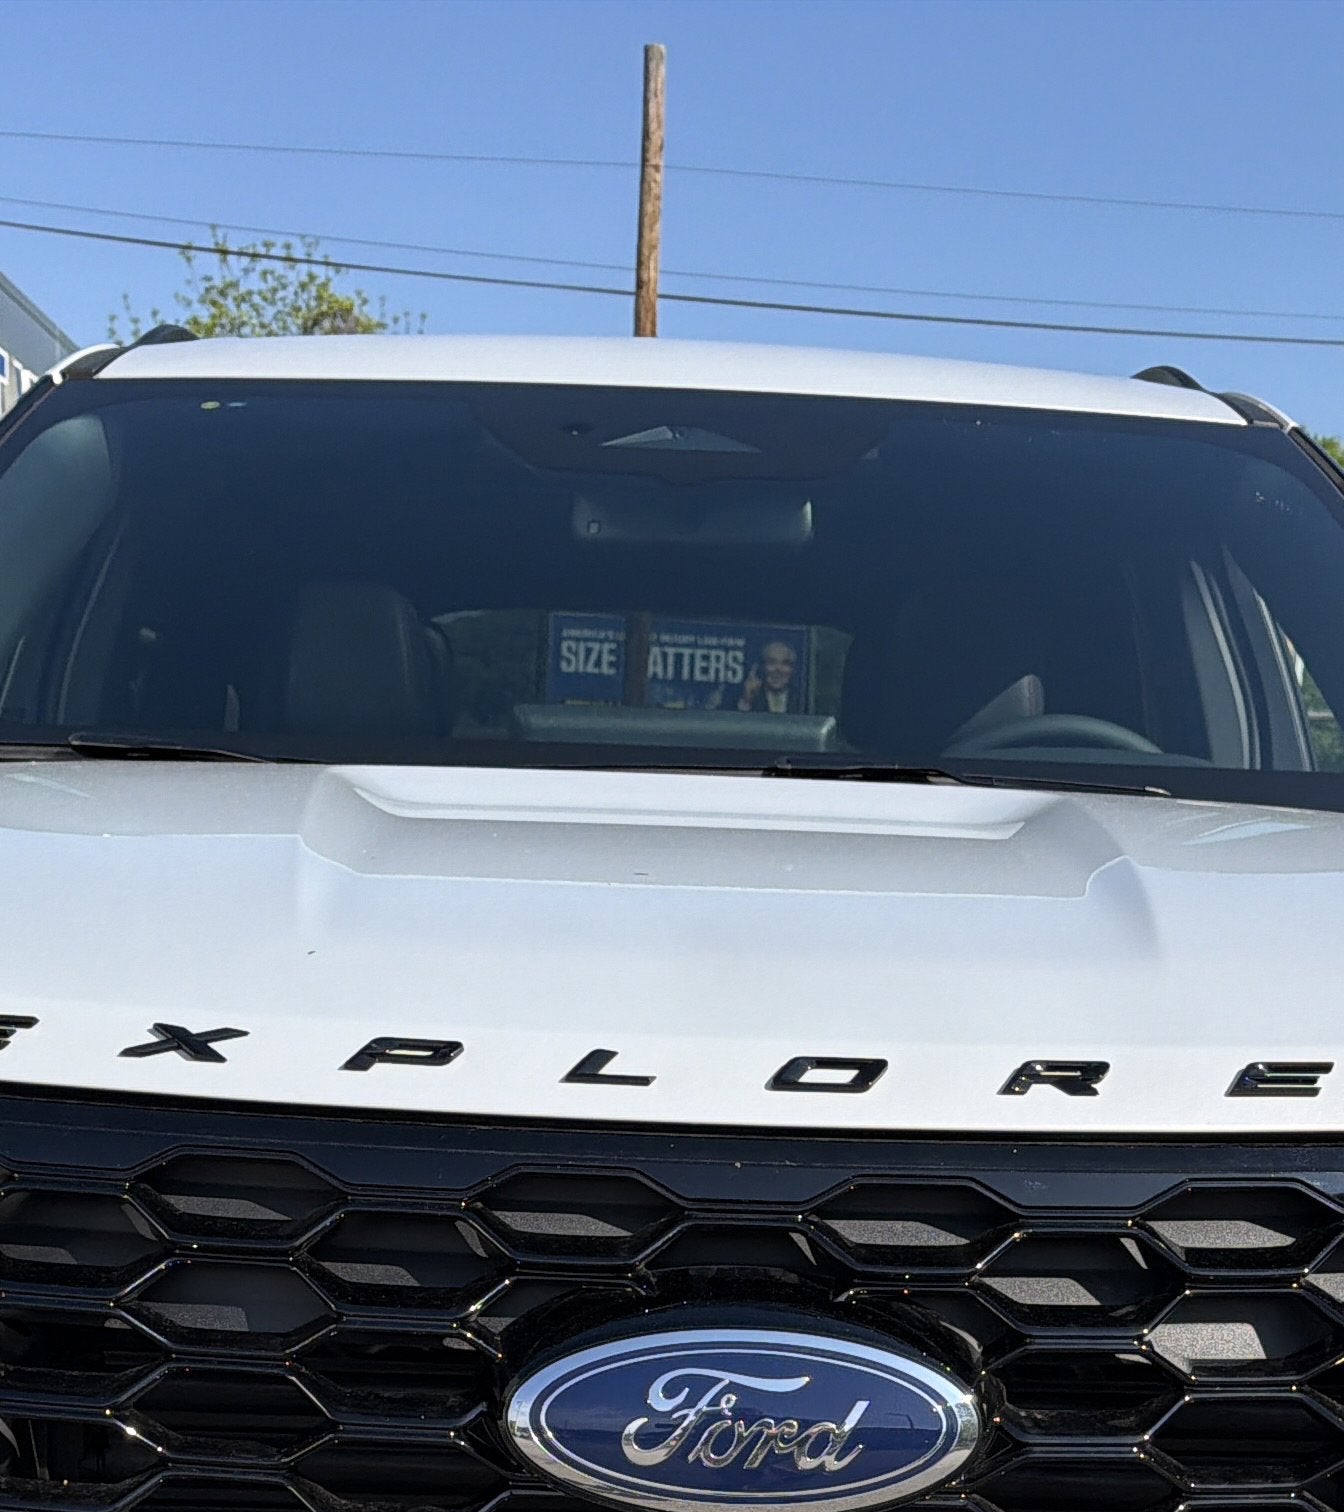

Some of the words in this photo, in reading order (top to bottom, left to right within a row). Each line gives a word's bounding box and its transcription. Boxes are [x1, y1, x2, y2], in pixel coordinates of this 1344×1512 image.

[560, 639, 617, 675] SIZE
[646, 646, 745, 684] ATTERS
[621, 1367, 870, 1472] Ford
